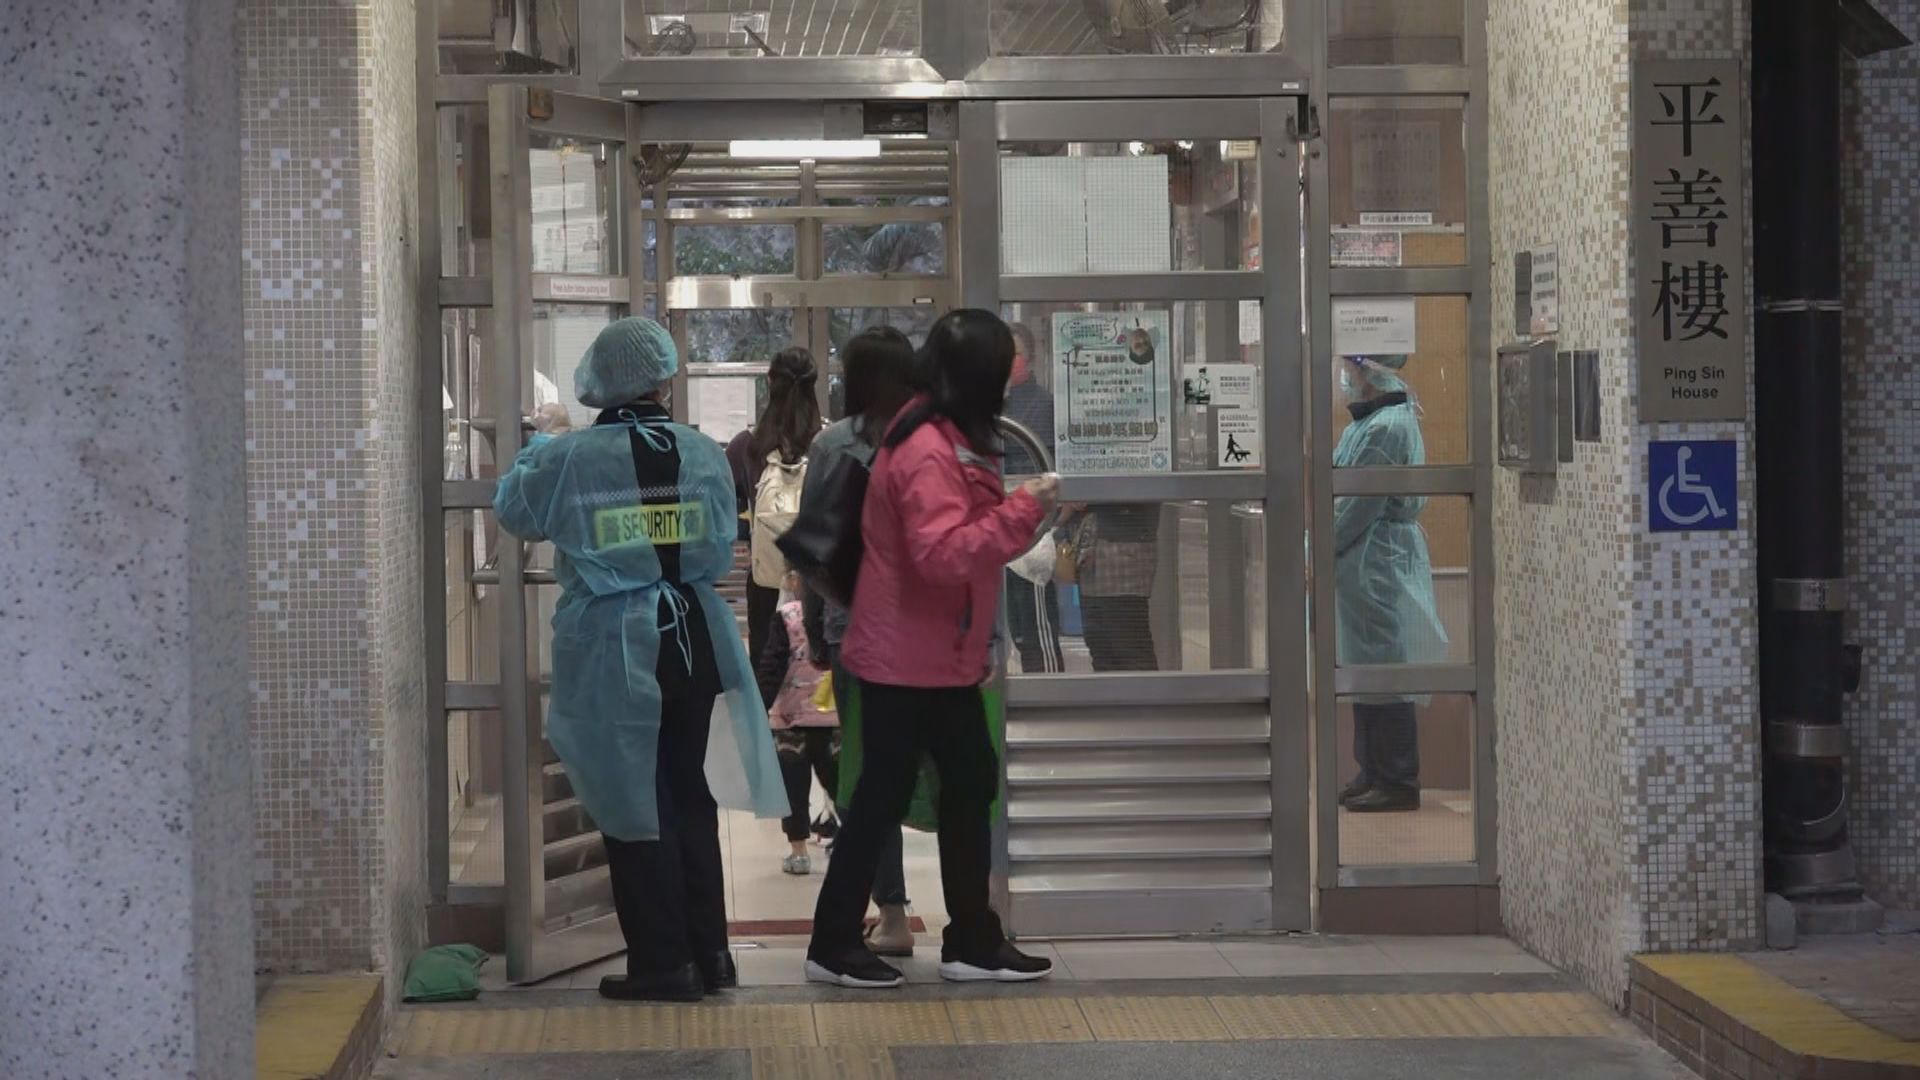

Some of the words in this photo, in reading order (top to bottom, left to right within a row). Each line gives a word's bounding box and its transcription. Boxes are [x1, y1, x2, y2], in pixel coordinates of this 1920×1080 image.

[1650, 77, 1729, 341] 平善樓
[1664, 367, 1697, 383] Ping
[1702, 365, 1725, 379] Sin
[1671, 386, 1719, 399] House
[622, 509, 682, 541] SECURITY
